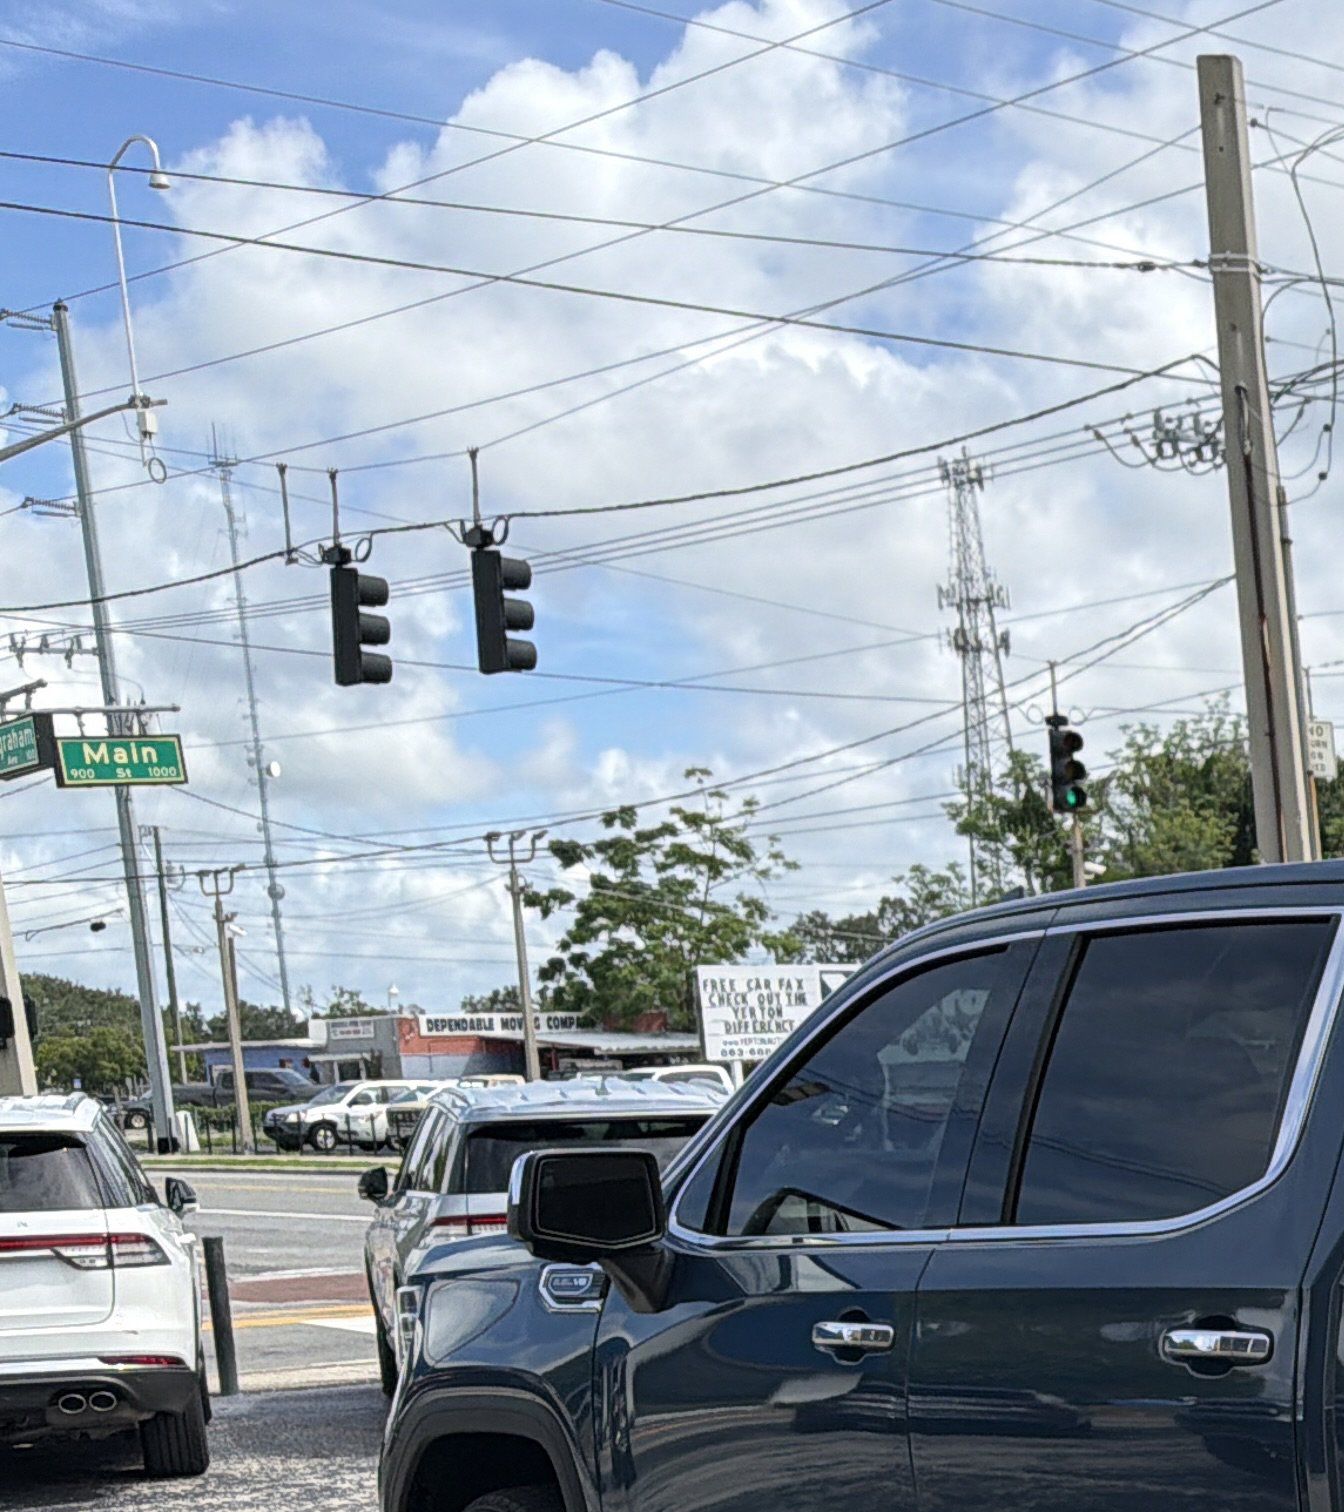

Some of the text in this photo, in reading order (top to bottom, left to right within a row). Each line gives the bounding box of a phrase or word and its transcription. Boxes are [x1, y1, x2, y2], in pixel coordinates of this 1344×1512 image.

[82, 742, 158, 765] Main
[70, 767, 177, 779] 900 St 1000
[703, 978, 804, 992] FREE CAR FAX
[708, 991, 749, 1007] CHECK
[757, 992, 781, 1005] OUT
[732, 1006, 783, 1020] YERTON
[426, 1018, 494, 1032] DEPENDABLE
[500, 1016, 540, 1031] MOVG
